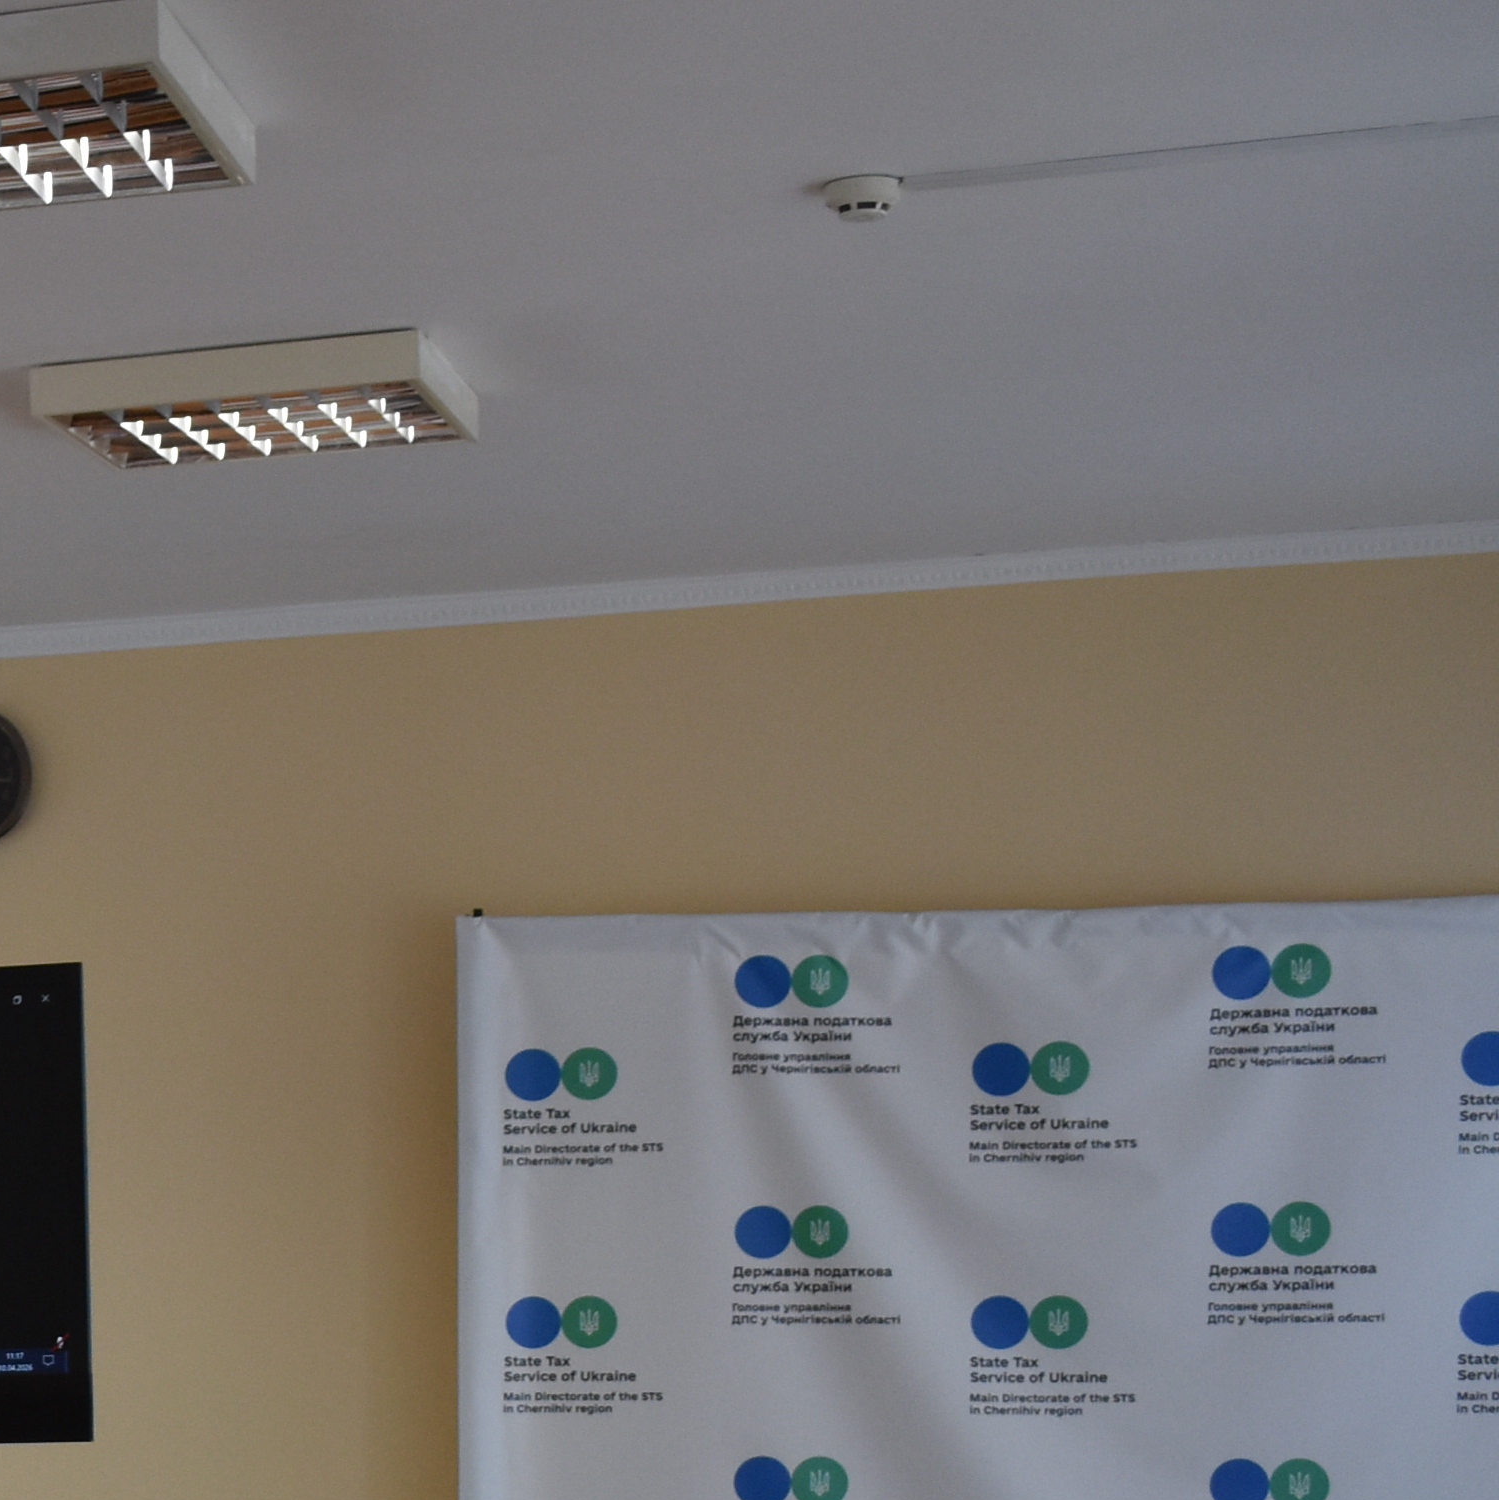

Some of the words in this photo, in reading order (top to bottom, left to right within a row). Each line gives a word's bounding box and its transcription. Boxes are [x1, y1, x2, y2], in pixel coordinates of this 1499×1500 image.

[1210, 1007, 1290, 1022] Державна
[1295, 1006, 1378, 1019] податкова
[732, 1015, 809, 1028] Державна
[814, 1017, 892, 1027] податкова
[1210, 1022, 1269, 1038] служба
[1274, 1021, 1335, 1035] України
[733, 1031, 788, 1044] служба
[794, 1030, 852, 1043] України
[1209, 1045, 1259, 1056] Головне
[1264, 1045, 1334, 1056] управління
[733, 1052, 780, 1061] Головне
[784, 1054, 851, 1063] управління
[1208, 1058, 1235, 1069] ДПС
[1239, 1060, 1247, 1069] у
[1250, 1055, 1335, 1068] Чернігівській
[1338, 1053, 1386, 1065] області
[732, 1064, 757, 1075] ДПС
[761, 1066, 768, 1075] у
[771, 1064, 852, 1074] Чернігівській
[855, 1064, 900, 1073] області
[1460, 1094, 1499, 1106] State
[503, 1108, 541, 1120] State
[546, 1108, 570, 1119] Tax
[970, 1103, 1010, 1116] State
[1015, 1103, 1039, 1115] Tax
[1460, 1110, 1499, 1122] Servi
[503, 1123, 557, 1135] Service
[561, 1123, 577, 1134] of
[580, 1122, 637, 1134] Ukraine
[970, 1119, 1026, 1131] Service
[1030, 1118, 1046, 1130] of
[1050, 1118, 1109, 1130] Ukraine
[1459, 1133, 1489, 1142] Main
[503, 1145, 531, 1154] Main
[535, 1144, 600, 1154] Directorate
[604, 1143, 616, 1152] of
[619, 1144, 639, 1152] the
[642, 1142, 663, 1152] STS
[969, 1142, 998, 1151] Main
[1003, 1140, 1071, 1150] Directorate
[1075, 1139, 1087, 1149] of
[1091, 1140, 1111, 1149] the
[1114, 1138, 1137, 1149] STS
[1458, 1145, 1470, 1154] in
[502, 1157, 513, 1166] in
[517, 1157, 572, 1166] Chernihiv
[576, 1156, 613, 1168] region
[969, 1154, 980, 1162] in
[983, 1153, 1042, 1163] Chernihiv
[1045, 1153, 1084, 1164] region
[733, 1266, 810, 1279] Державна
[814, 1268, 892, 1278] податкова
[1208, 1264, 1289, 1278] Державна
[1294, 1265, 1377, 1276] податкова
[733, 1281, 789, 1295] служба
[794, 1281, 852, 1294] України
[1209, 1279, 1267, 1294] служба
[1273, 1278, 1334, 1292] України
[732, 1303, 780, 1312] Головне
[784, 1305, 851, 1313] управління
[1208, 1301, 1258, 1312] Головне
[1262, 1302, 1333, 1312] управління
[731, 1315, 757, 1325] ДПС
[761, 1317, 768, 1326] у
[771, 1315, 852, 1325] Чернігівській
[855, 1315, 901, 1324] області
[1207, 1315, 1234, 1325] ДПС
[1238, 1316, 1245, 1326] у
[1249, 1313, 1334, 1325] Чернігівській
[1338, 1313, 1385, 1323] області
[504, 1356, 541, 1367] State
[546, 1356, 570, 1367] Tax
[970, 1356, 1009, 1368] State
[1013, 1357, 1038, 1367] Tax
[1458, 1354, 1499, 1365] State
[504, 1371, 557, 1382] Service
[561, 1370, 577, 1382] of
[580, 1370, 636, 1382] Ukraine
[970, 1372, 1025, 1383] Service
[1029, 1372, 1045, 1383] of
[1049, 1371, 1108, 1383] Ukraine
[1458, 1369, 1499, 1381] Servi
[503, 1392, 531, 1401] Main
[535, 1392, 600, 1401] Directorate
[603, 1392, 616, 1401] of
[619, 1392, 638, 1401] the
[641, 1392, 663, 1401] STS
[969, 1394, 998, 1402] Main
[1002, 1394, 1070, 1403] Directorate
[1073, 1394, 1086, 1403] of
[1089, 1394, 1110, 1403] the
[1113, 1393, 1136, 1403] STS
[1457, 1392, 1488, 1401] Main
[503, 1405, 514, 1413] in
[517, 1404, 572, 1413] Chernihiv
[575, 1404, 612, 1415] region
[970, 1406, 980, 1414] in
[984, 1406, 1040, 1415] Chernihiv
[1044, 1406, 1083, 1417] region
[1457, 1405, 1468, 1413] in
